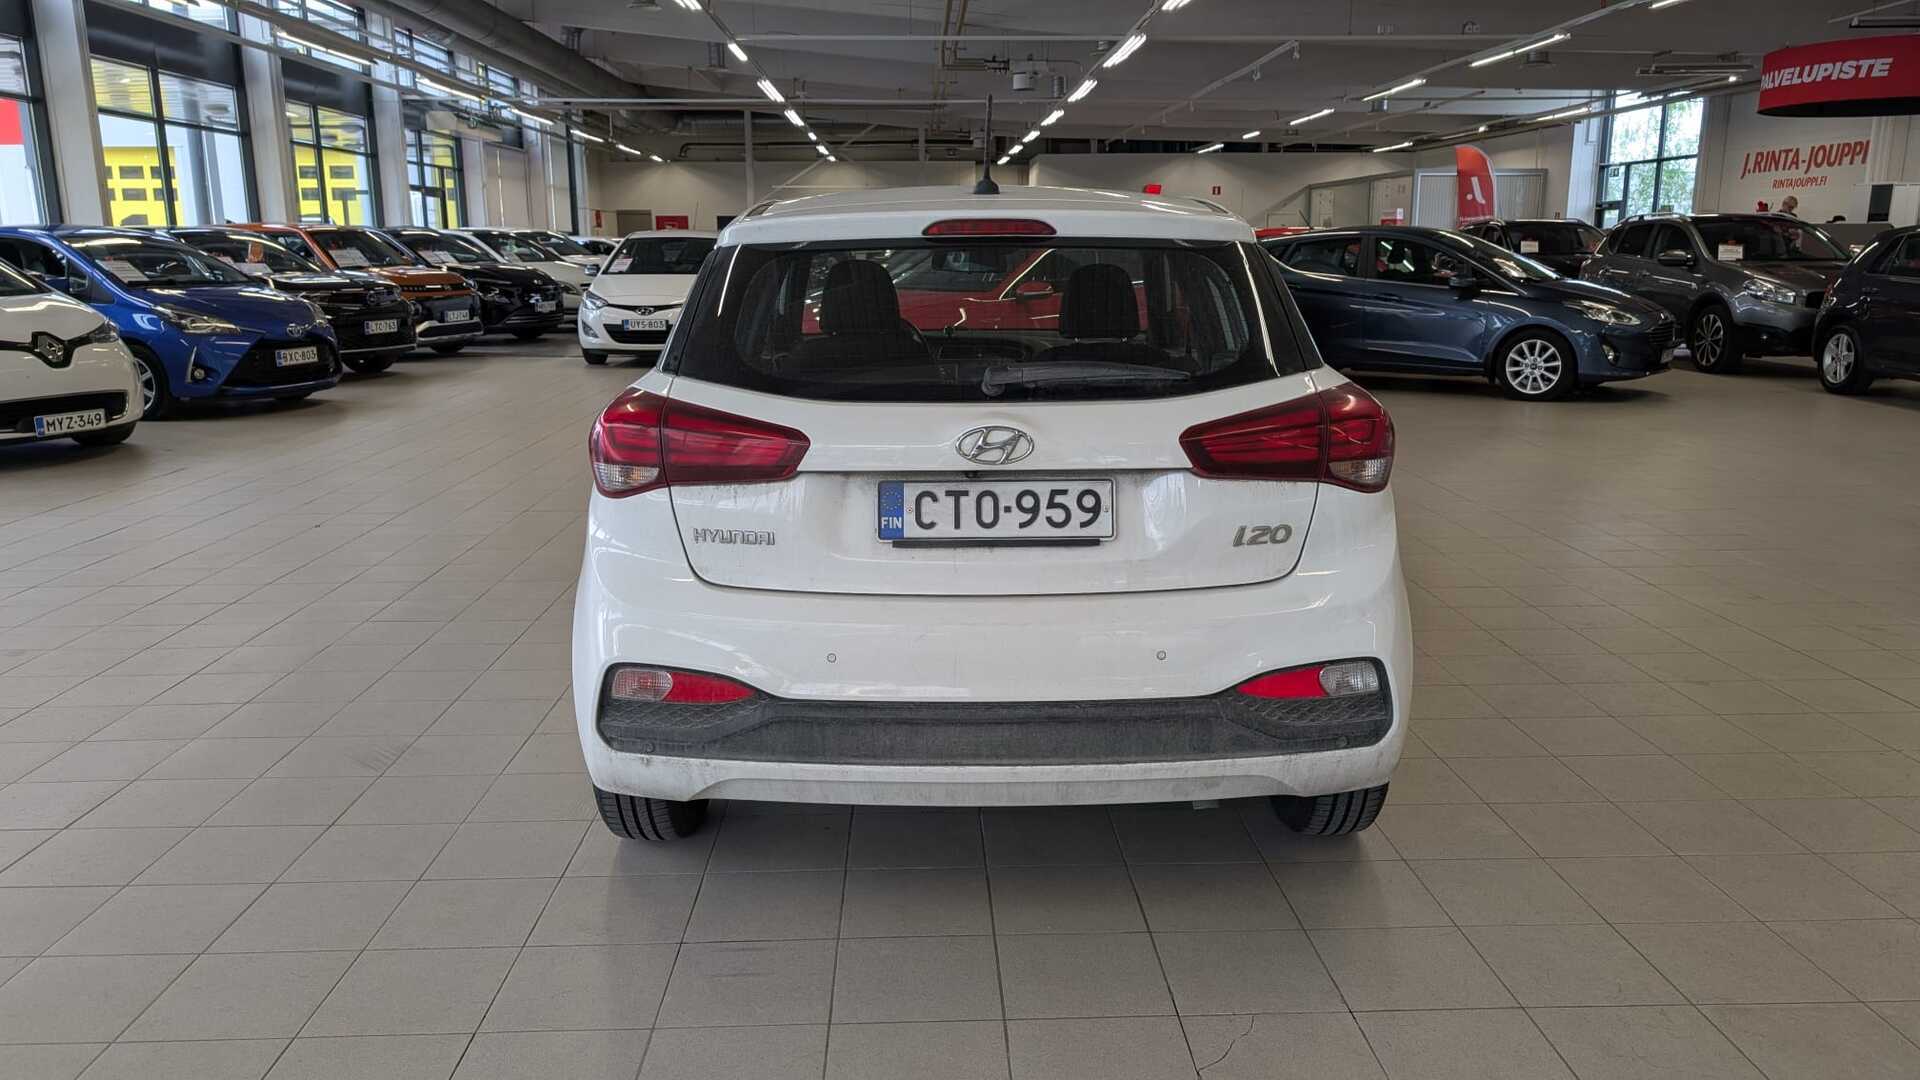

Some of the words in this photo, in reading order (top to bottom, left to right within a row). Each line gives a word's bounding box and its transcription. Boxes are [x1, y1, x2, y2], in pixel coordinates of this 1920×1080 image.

[1741, 139, 1870, 179] J.RINTA-JOUPPI
[1772, 176, 1828, 189] RINTAJOUPPI.FI
[283, 349, 316, 363] BXC-803
[46, 413, 102, 432] MYZ-349
[914, 489, 1102, 530] CTO-959
[881, 516, 902, 529] FIN
[693, 528, 775, 545] HYUNDAI
